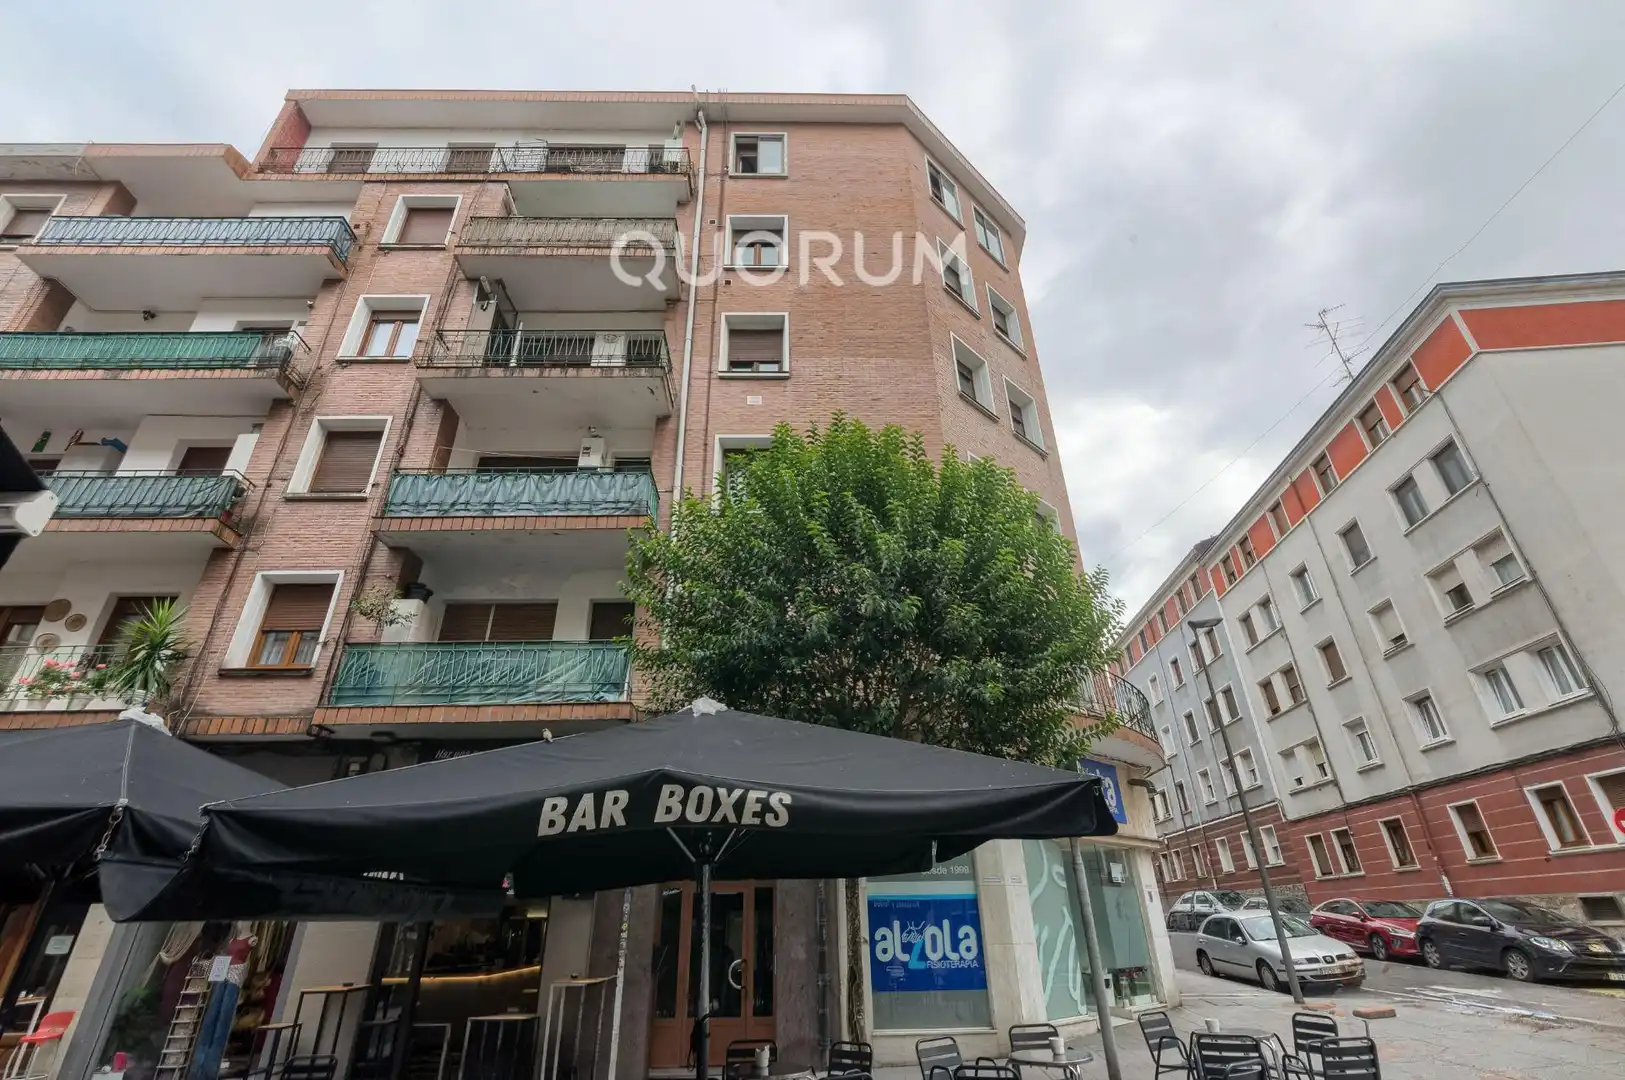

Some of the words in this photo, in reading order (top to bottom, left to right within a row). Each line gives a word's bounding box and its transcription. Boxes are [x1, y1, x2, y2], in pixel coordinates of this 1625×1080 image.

[537, 789, 629, 837] BAR
[654, 784, 792, 827] BOXES
[926, 960, 979, 969] FISIOTERAPIA
